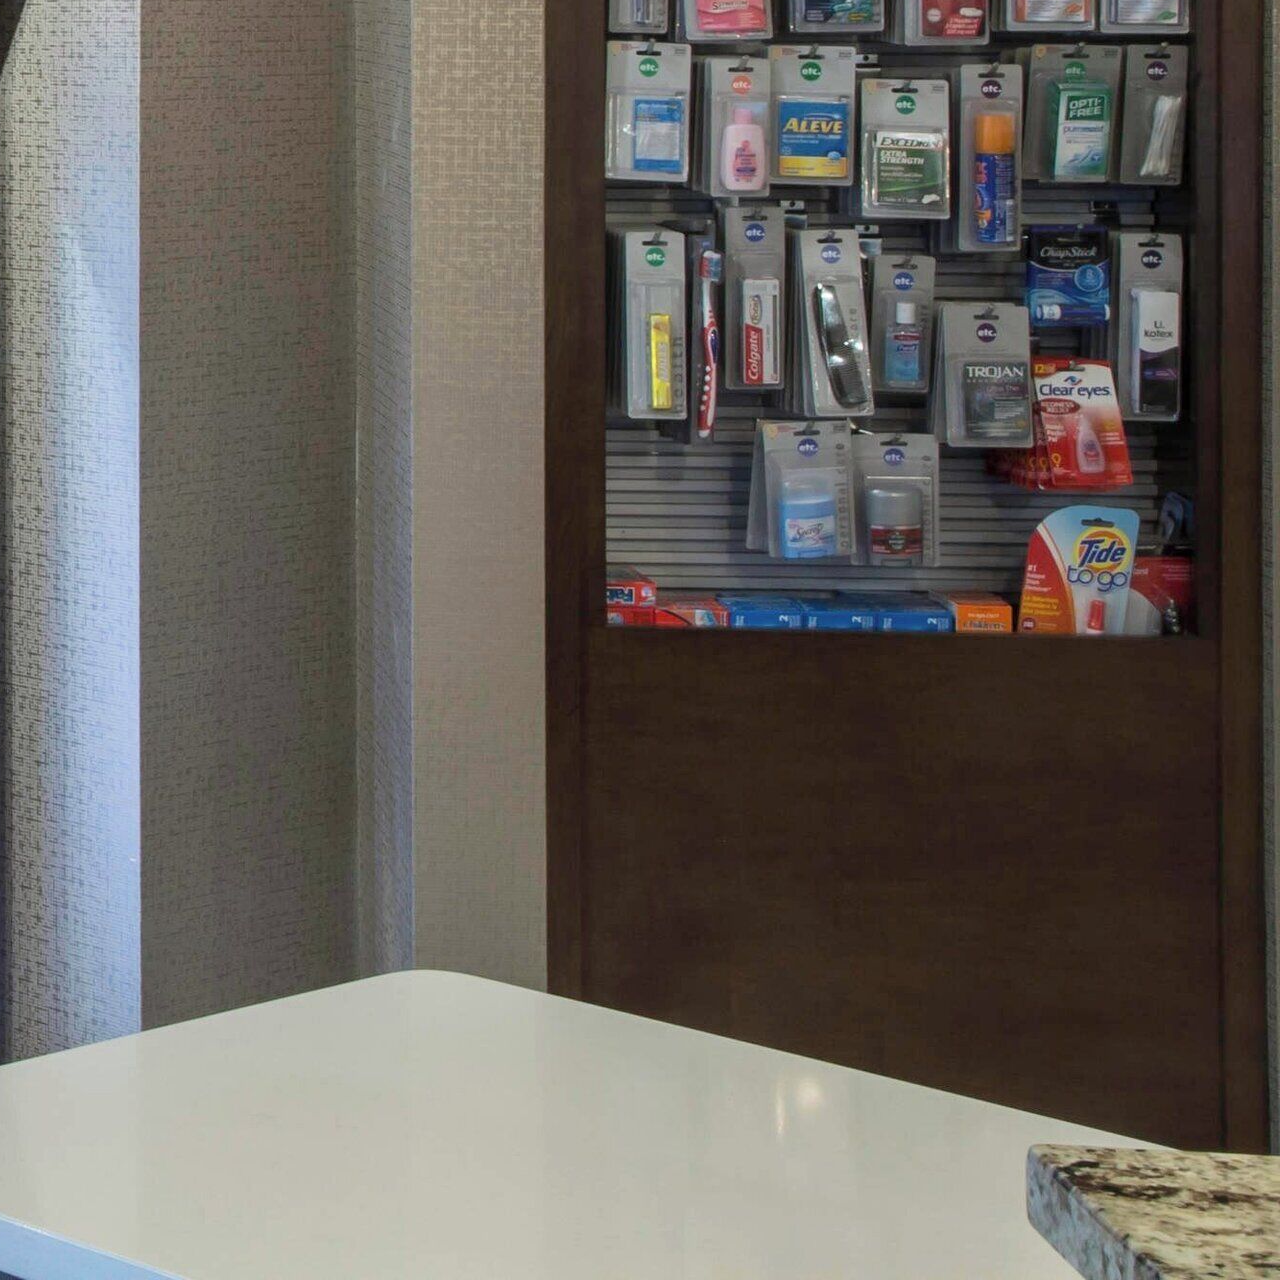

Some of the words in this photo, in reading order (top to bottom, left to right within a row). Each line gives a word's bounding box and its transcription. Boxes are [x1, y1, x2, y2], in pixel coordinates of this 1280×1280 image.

[1068, 107, 1103, 119] FREE
[783, 117, 843, 134] ALEVE
[747, 329, 760, 380] Colgate
[966, 365, 1025, 379] TROJAN
[1040, 384, 1075, 396] Clear
[1077, 385, 1112, 400] eyes
[1077, 538, 1128, 568] Tide
[1066, 565, 1094, 585] to
[1096, 570, 1129, 593] go
